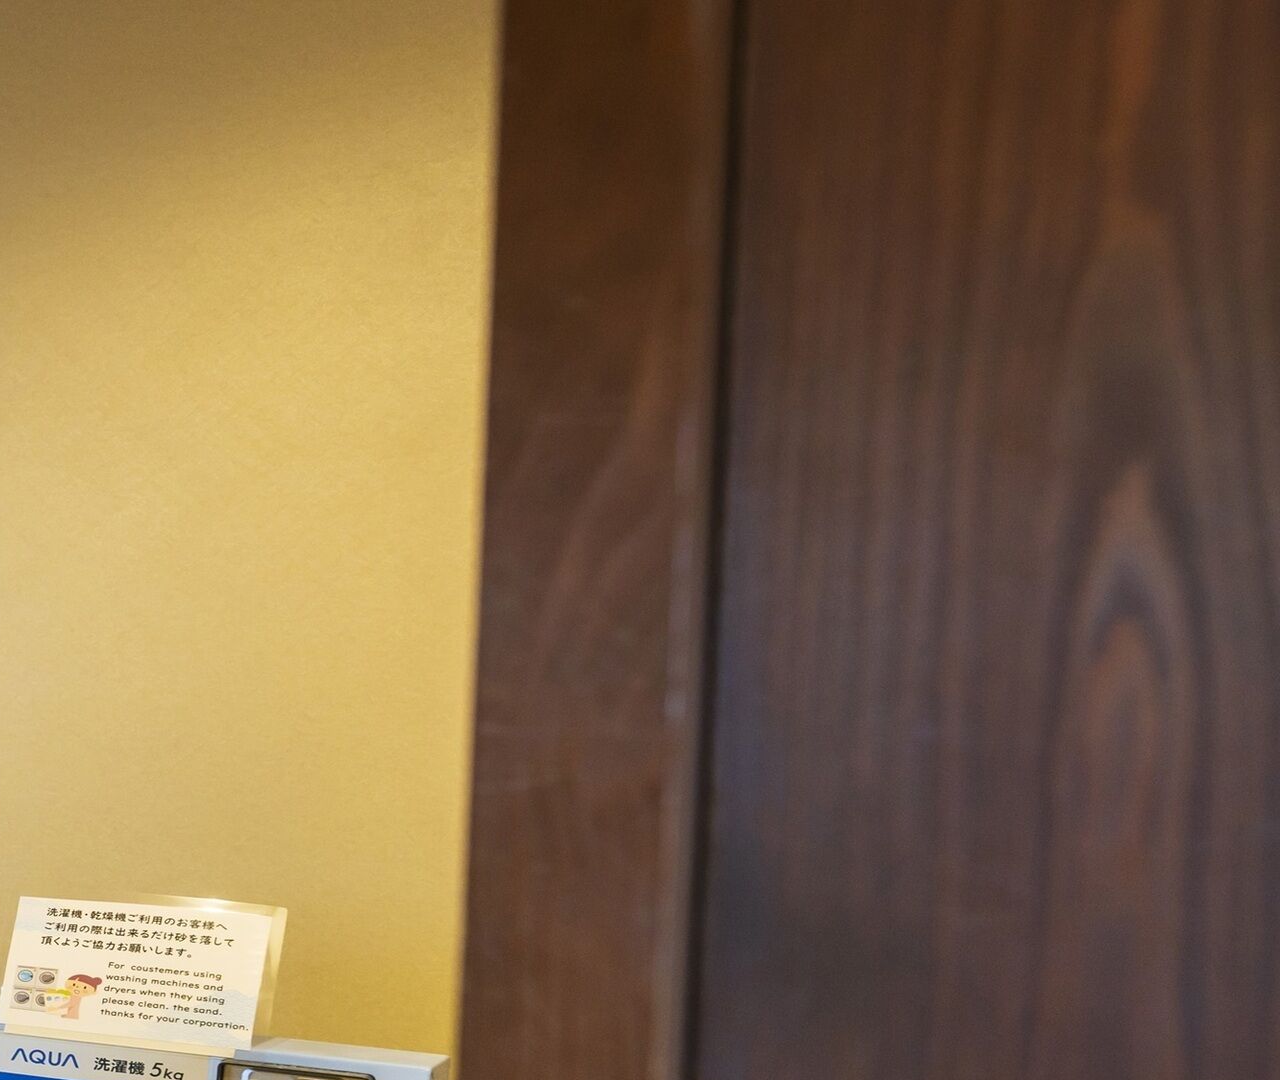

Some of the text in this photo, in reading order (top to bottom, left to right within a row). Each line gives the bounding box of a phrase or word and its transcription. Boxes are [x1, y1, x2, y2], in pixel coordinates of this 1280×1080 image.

[47, 907, 227, 930] 洗濯機・乾燥機ご利用のお客様へ
[44, 921, 235, 947] ご利用の際は出来るだけ砂を落して
[41, 935, 192, 958] 頂くようご協力お願いします。
[106, 973, 223, 992] washing machines and
[131, 964, 189, 976] coustemers
[193, 971, 222, 981] using
[102, 997, 135, 1006] please
[173, 1004, 190, 1012] the
[193, 1007, 222, 1016] sand.
[104, 985, 225, 1005] dryers when they using
[100, 1008, 249, 1031] thanks for your corporation.
[11, 1047, 79, 1069] AQUA
[94, 1057, 145, 1076] 洗濯機
